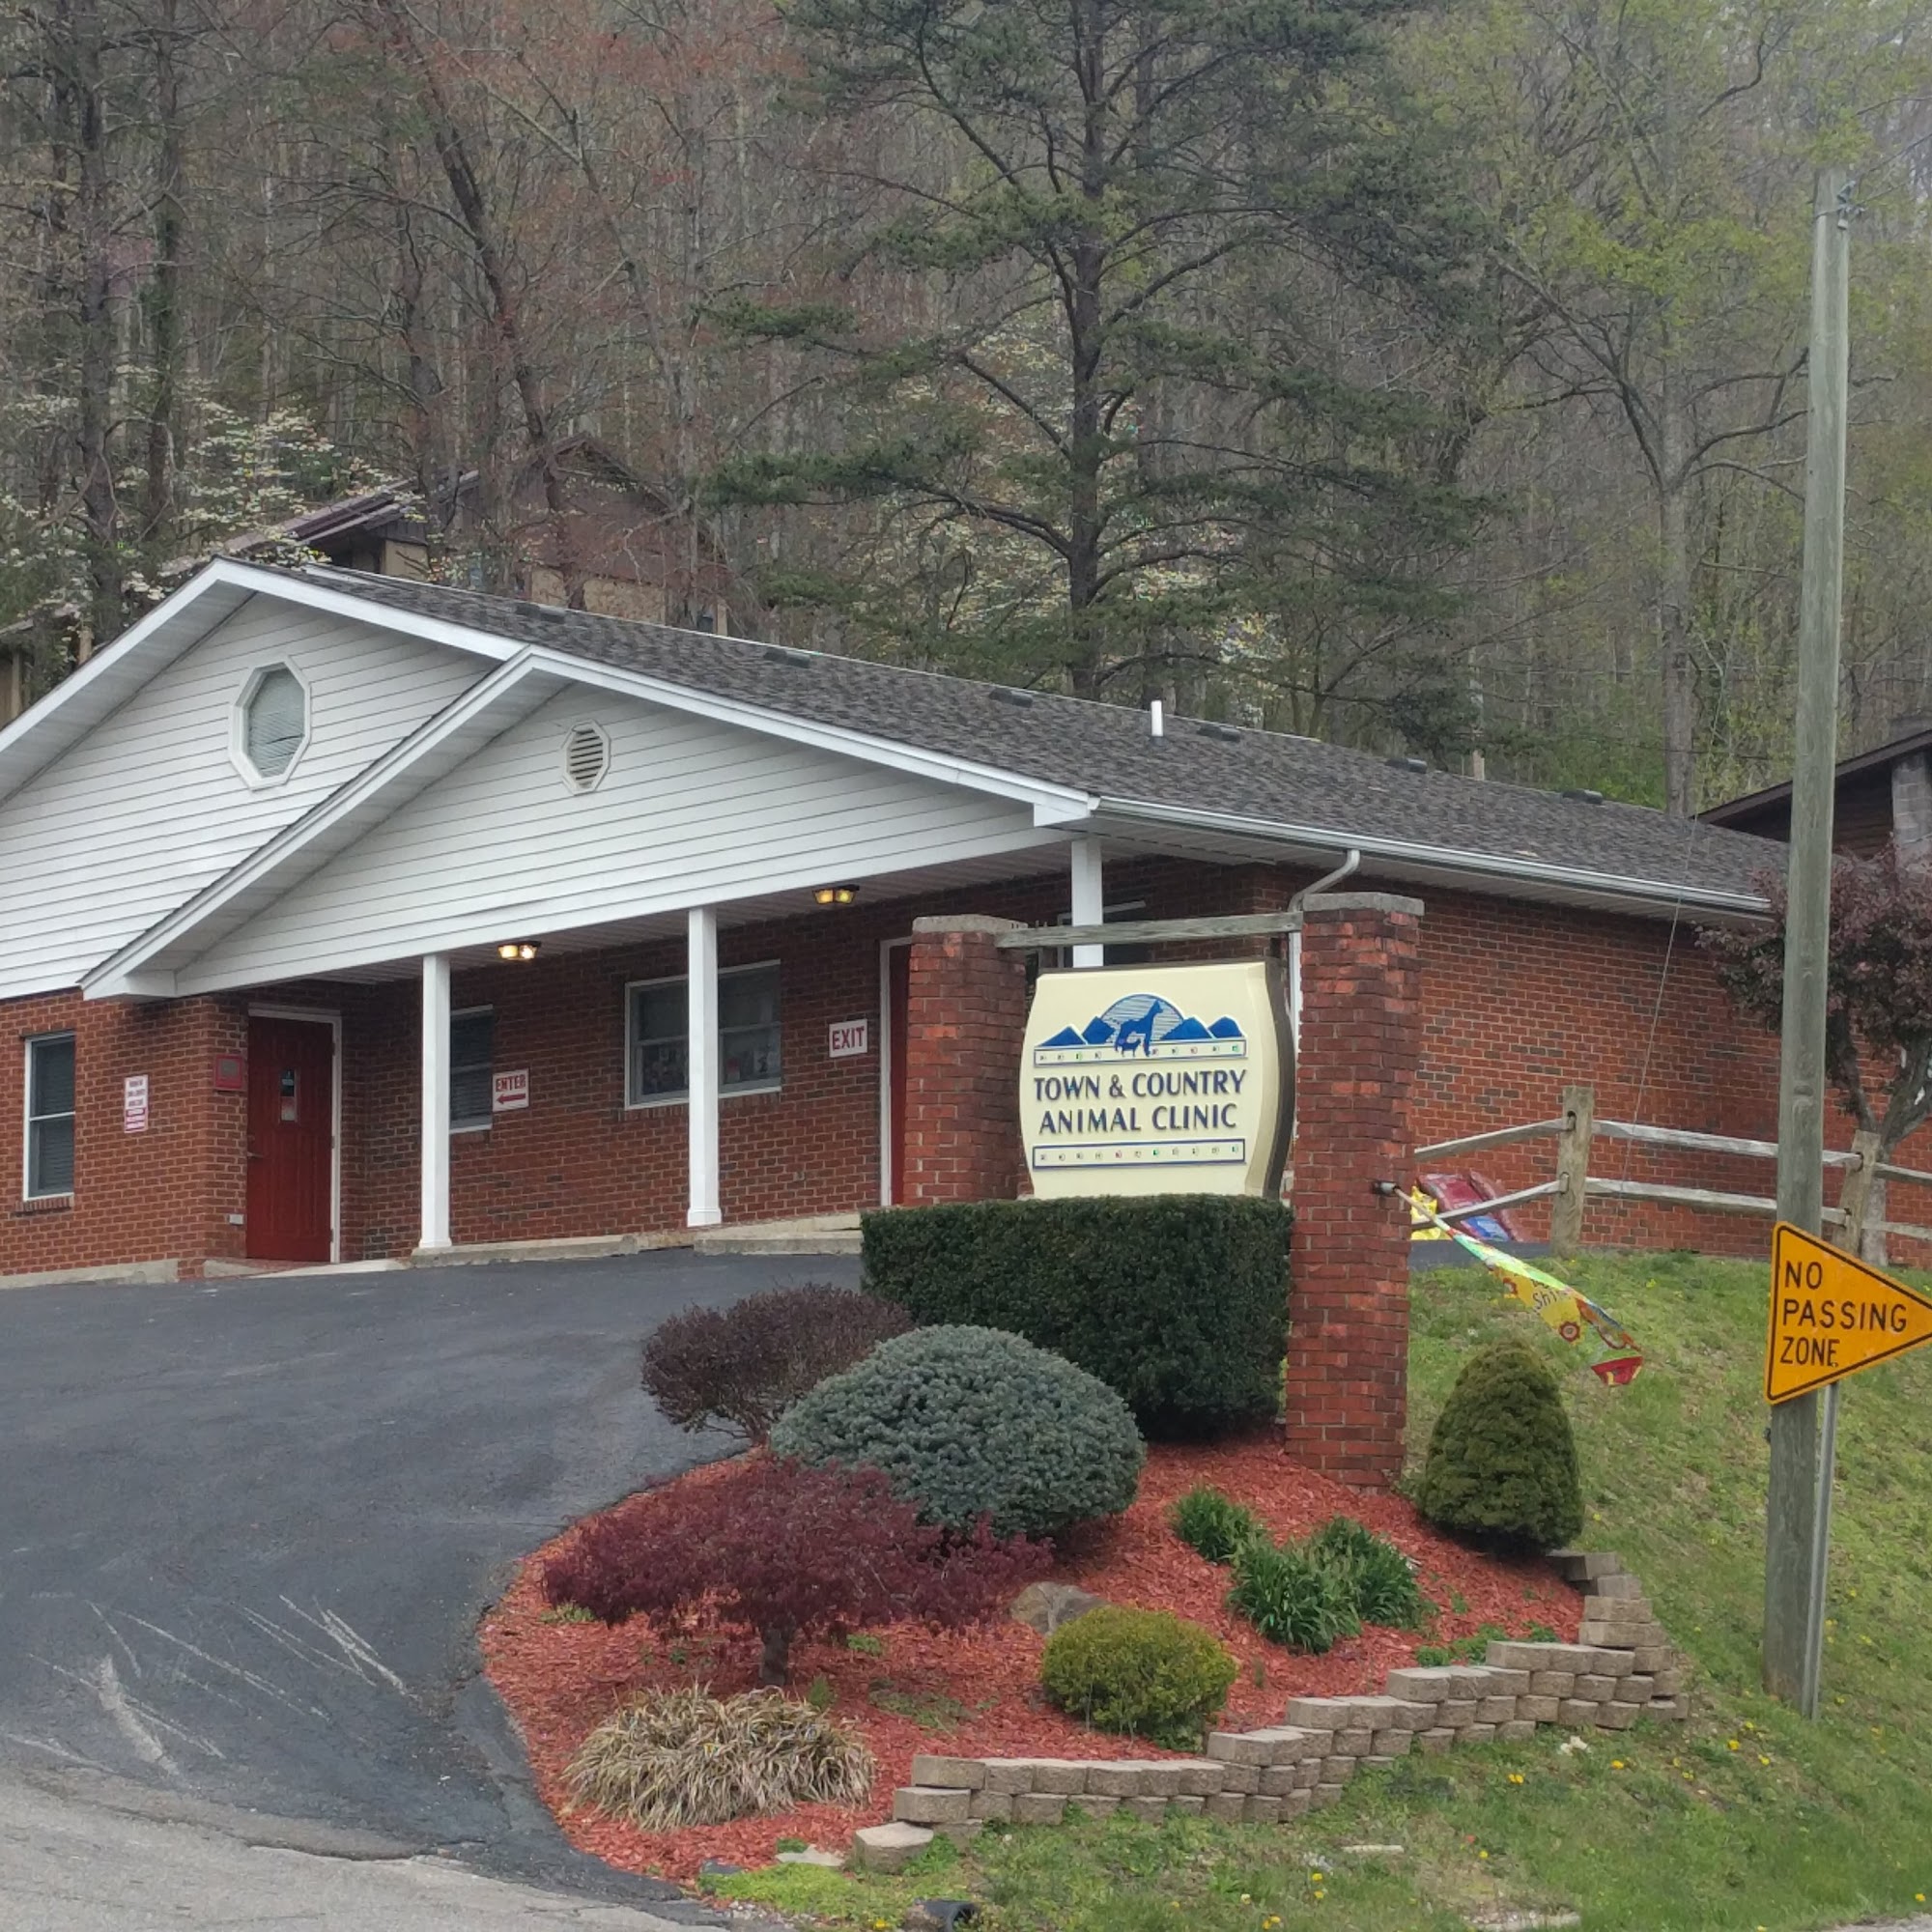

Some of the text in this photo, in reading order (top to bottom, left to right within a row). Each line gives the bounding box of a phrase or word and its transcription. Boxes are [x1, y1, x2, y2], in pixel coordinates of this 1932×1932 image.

[832, 1026, 865, 1051] EXIT
[496, 1074, 526, 1092] ENTER
[1034, 1069, 1246, 1101] TOWN & COUNTRY
[1038, 1103, 1236, 1135] ANIMAL CLINIC
[1784, 1261, 1823, 1290] NO
[1782, 1298, 1907, 1333] PASSING
[1779, 1336, 1840, 1368] ZONE
